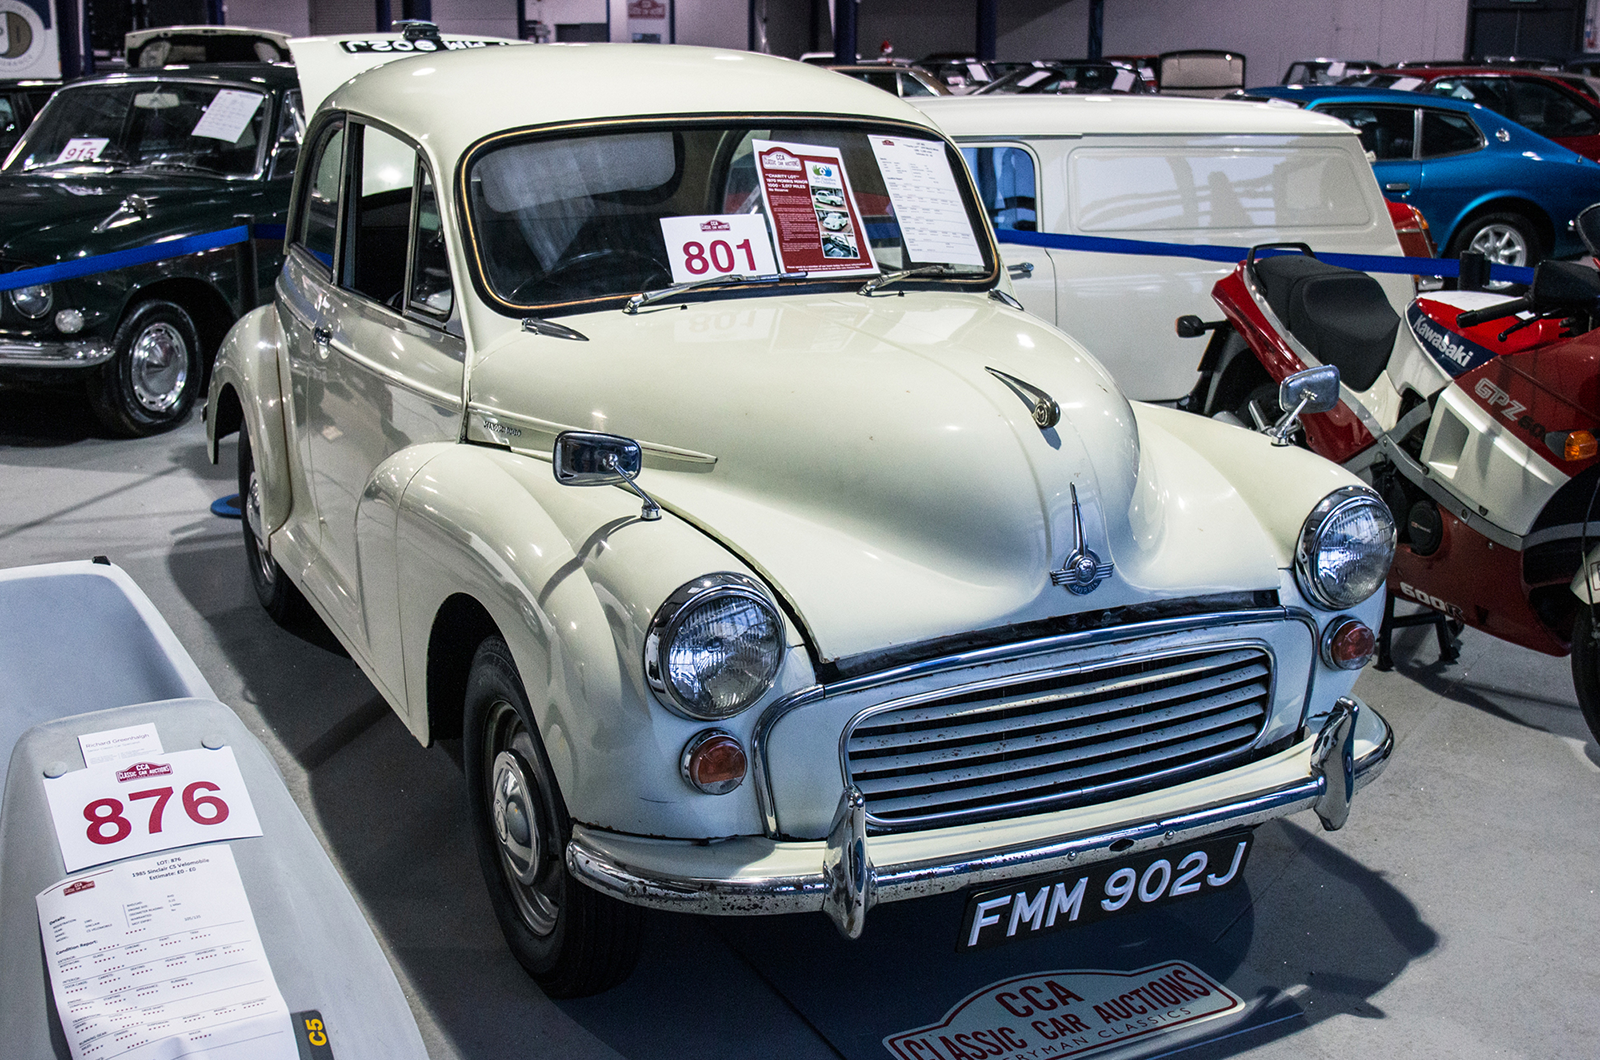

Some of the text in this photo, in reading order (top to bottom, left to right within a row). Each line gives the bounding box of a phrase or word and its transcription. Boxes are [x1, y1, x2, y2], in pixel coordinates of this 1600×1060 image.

[65, 148, 97, 160] 915
[682, 239, 756, 275] 801
[1413, 314, 1473, 368] Kawasaki
[1474, 378, 1527, 422] GPZ
[1072, 582, 1098, 594] MORRIS
[1400, 582, 1466, 621] 600R
[112, 734, 150, 744] Greenhalgh
[120, 771, 138, 779] CLASSIC
[148, 766, 170, 774] AUCTIONS
[83, 781, 230, 845] 876
[149, 872, 176, 880] Estimate:
[177, 859, 209, 868] Velomobile
[968, 842, 1247, 946] FMM 902J
[56, 945, 79, 955] Condition
[903, 969, 1210, 1060] CLASSIC CAR AUCTIONS
[995, 980, 1085, 1018] CCA
[305, 1018, 327, 1046] C5
[1098, 1008, 1192, 1039] CLASSICS
